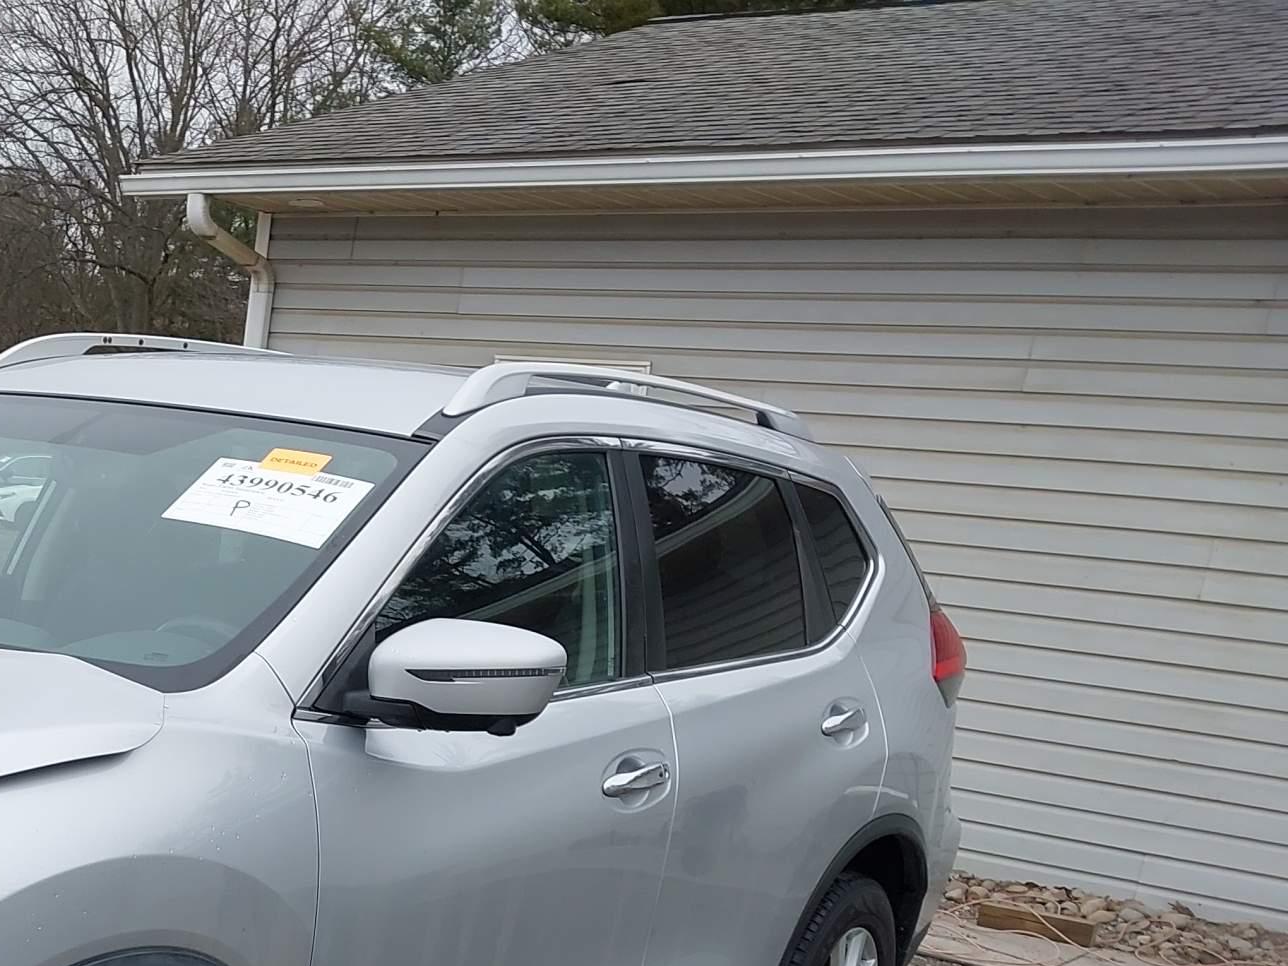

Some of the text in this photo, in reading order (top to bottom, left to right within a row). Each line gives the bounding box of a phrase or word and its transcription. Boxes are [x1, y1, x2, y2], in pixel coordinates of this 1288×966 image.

[270, 456, 318, 468] DETAILED
[217, 473, 342, 503] 43990546
[230, 499, 251, 516] P
